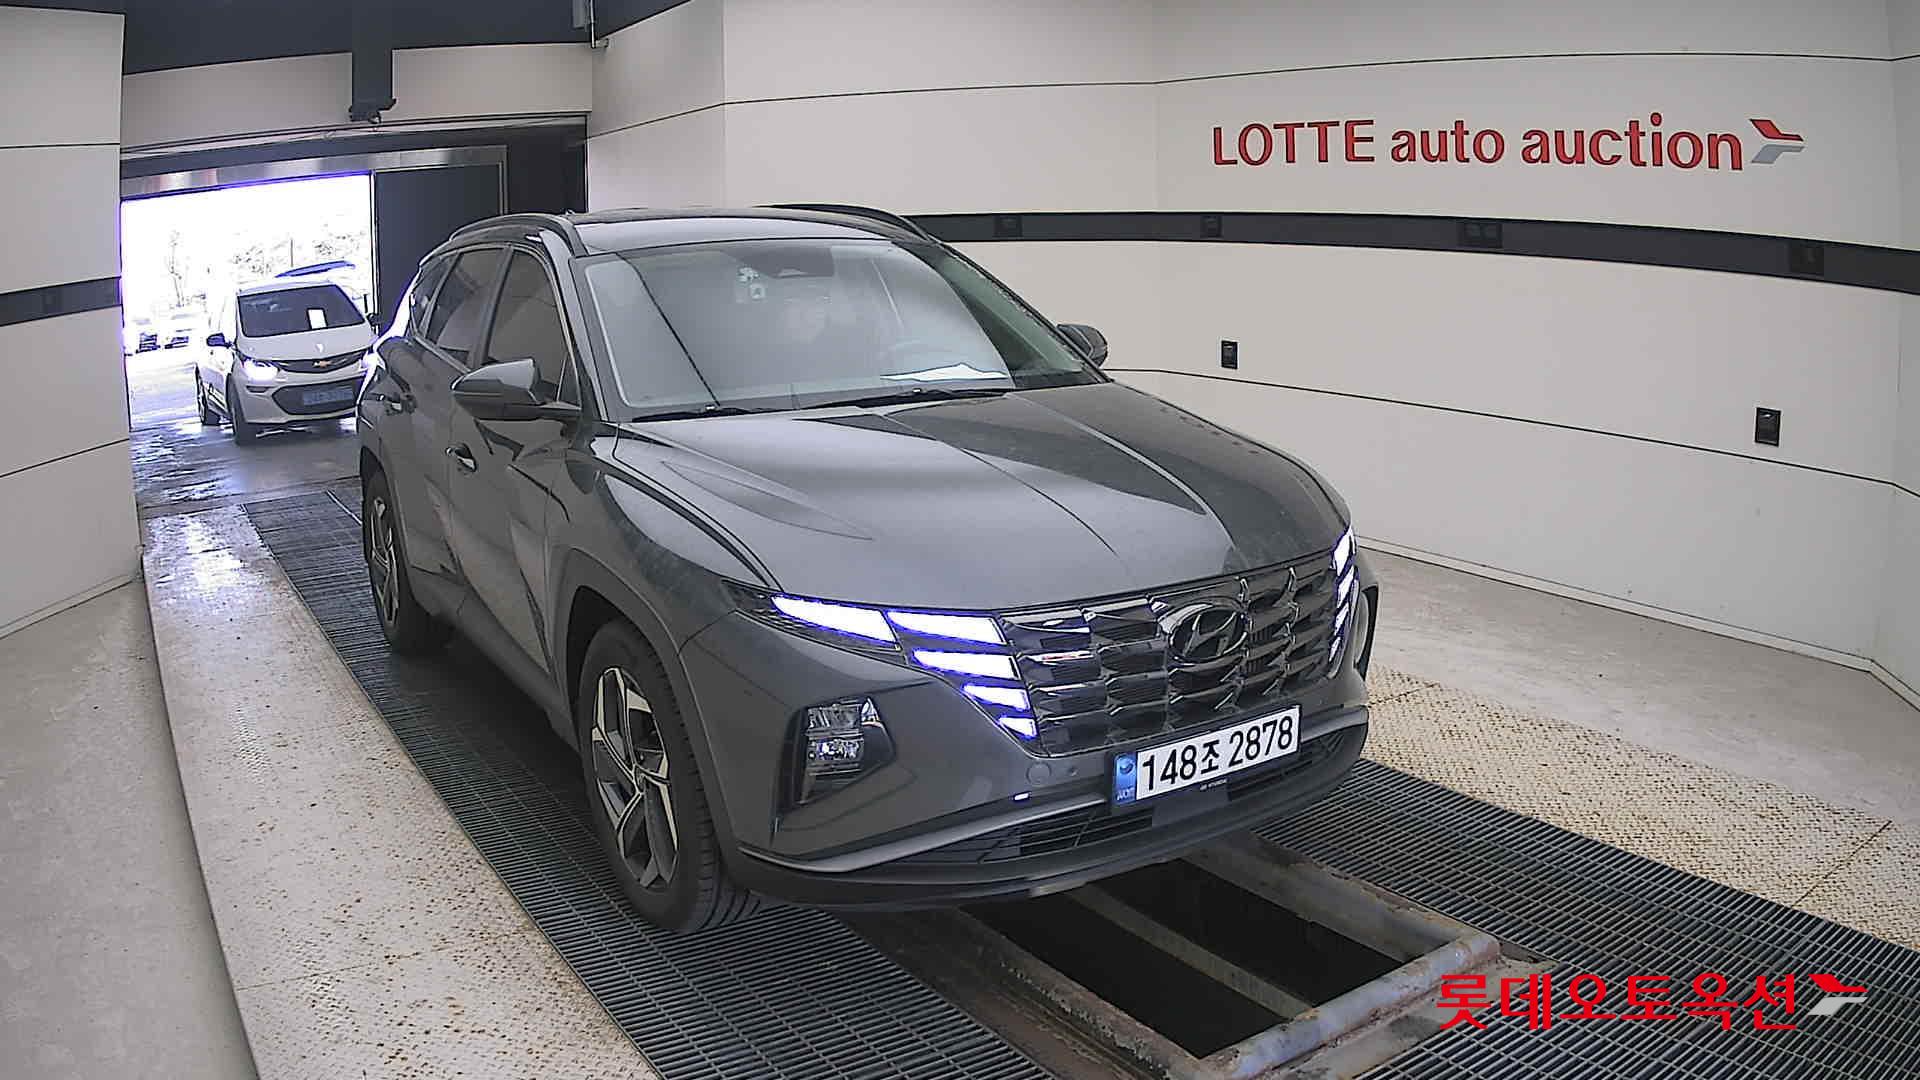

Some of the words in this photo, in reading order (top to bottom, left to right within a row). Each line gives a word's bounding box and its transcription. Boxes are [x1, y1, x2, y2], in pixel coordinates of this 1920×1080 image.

[1212, 119, 1376, 166] LOTTE
[1390, 119, 1505, 164] auto
[1520, 112, 1743, 170] auction
[1142, 738, 1221, 791] 148조
[1228, 715, 1294, 768] 2878
